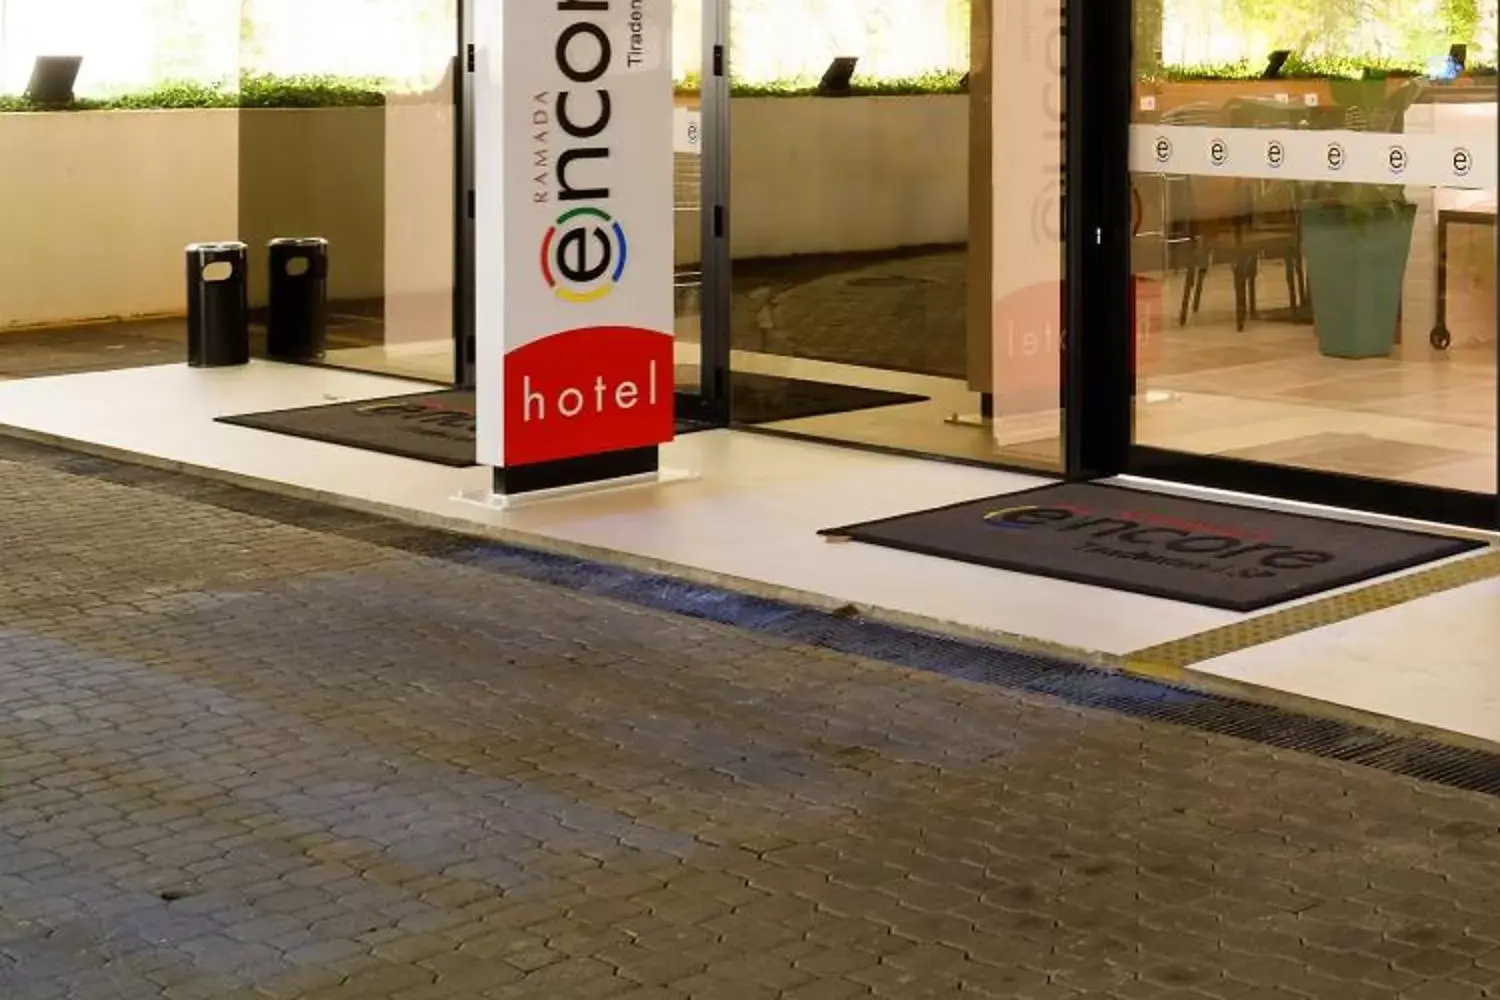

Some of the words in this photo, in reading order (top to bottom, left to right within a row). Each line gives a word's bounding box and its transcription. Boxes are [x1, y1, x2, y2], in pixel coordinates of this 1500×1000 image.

[533, 89, 549, 204] RAMADA
[1156, 139, 1170, 160] e
[1210, 141, 1225, 163] e
[1267, 143, 1282, 165] e
[1326, 145, 1342, 168] e
[1388, 148, 1404, 171] e
[1452, 150, 1468, 173] e
[523, 359, 656, 422] hotel
[1000, 507, 1335, 569] encore
